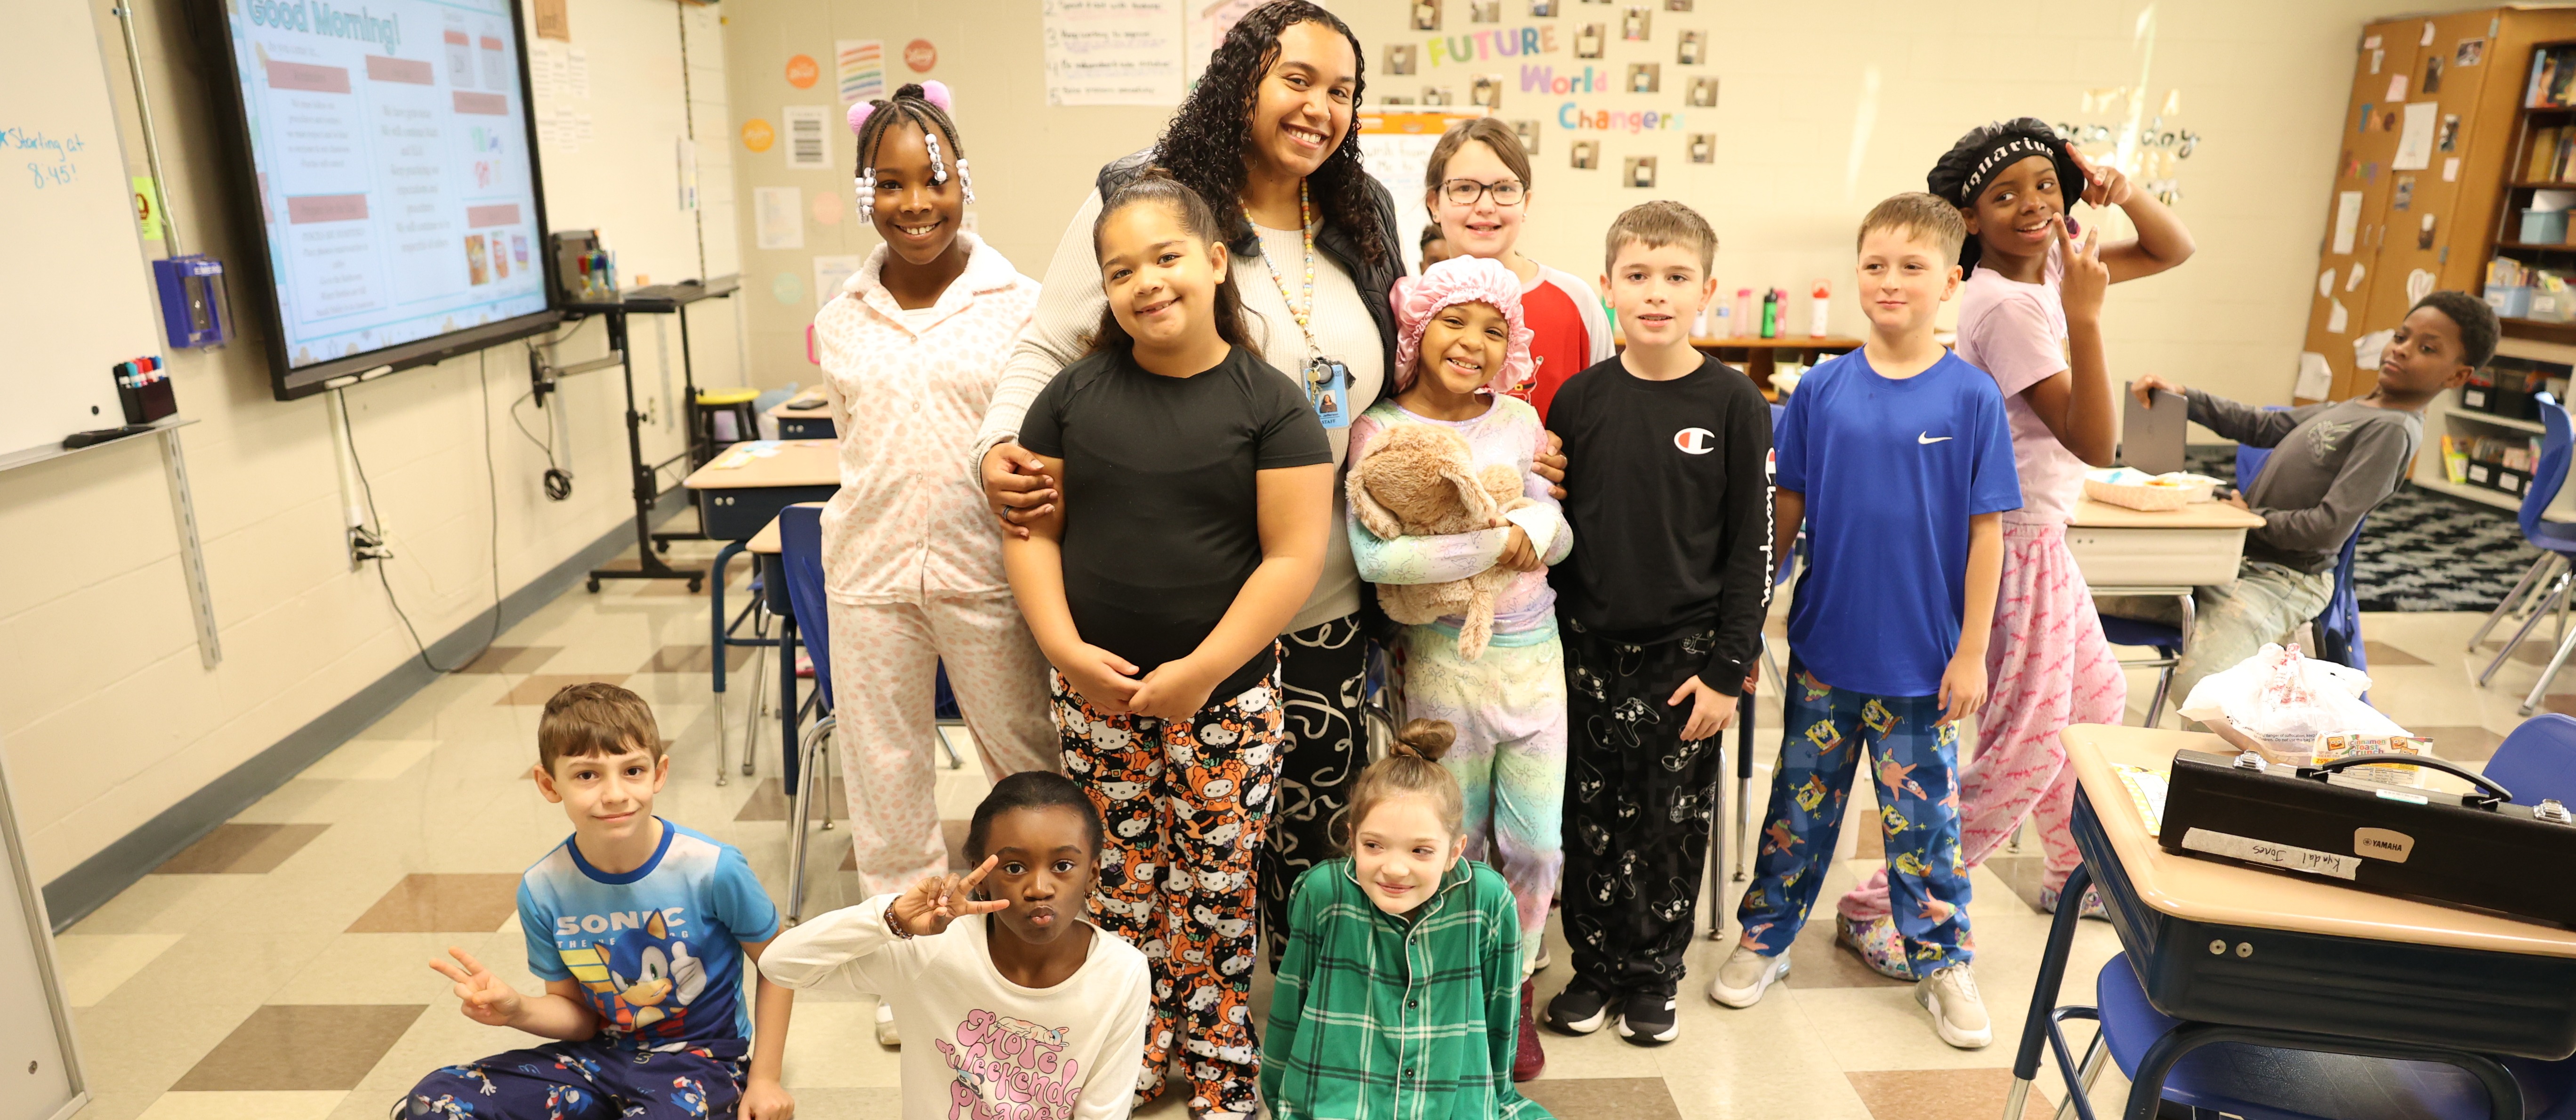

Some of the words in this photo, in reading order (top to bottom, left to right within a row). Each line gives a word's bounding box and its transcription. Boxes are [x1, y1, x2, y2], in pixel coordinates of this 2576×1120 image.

[247, 0, 309, 33] Good
[312, 1, 402, 56] Morning!
[1427, 25, 1559, 68] FUTURE
[1521, 63, 1609, 94] World
[1558, 102, 1685, 134] Changers
[8, 126, 65, 162] Starting
[67, 133, 85, 152] at
[2142, 115, 2201, 159] day
[27, 162, 78, 189] 8:45!
[2253, 846, 2286, 862] Jones
[2373, 839, 2402, 852] YAMAHA
[2302, 852, 2340, 872] Kyndal
[556, 940, 587, 949] THE
[957, 1009, 1063, 1074] More
